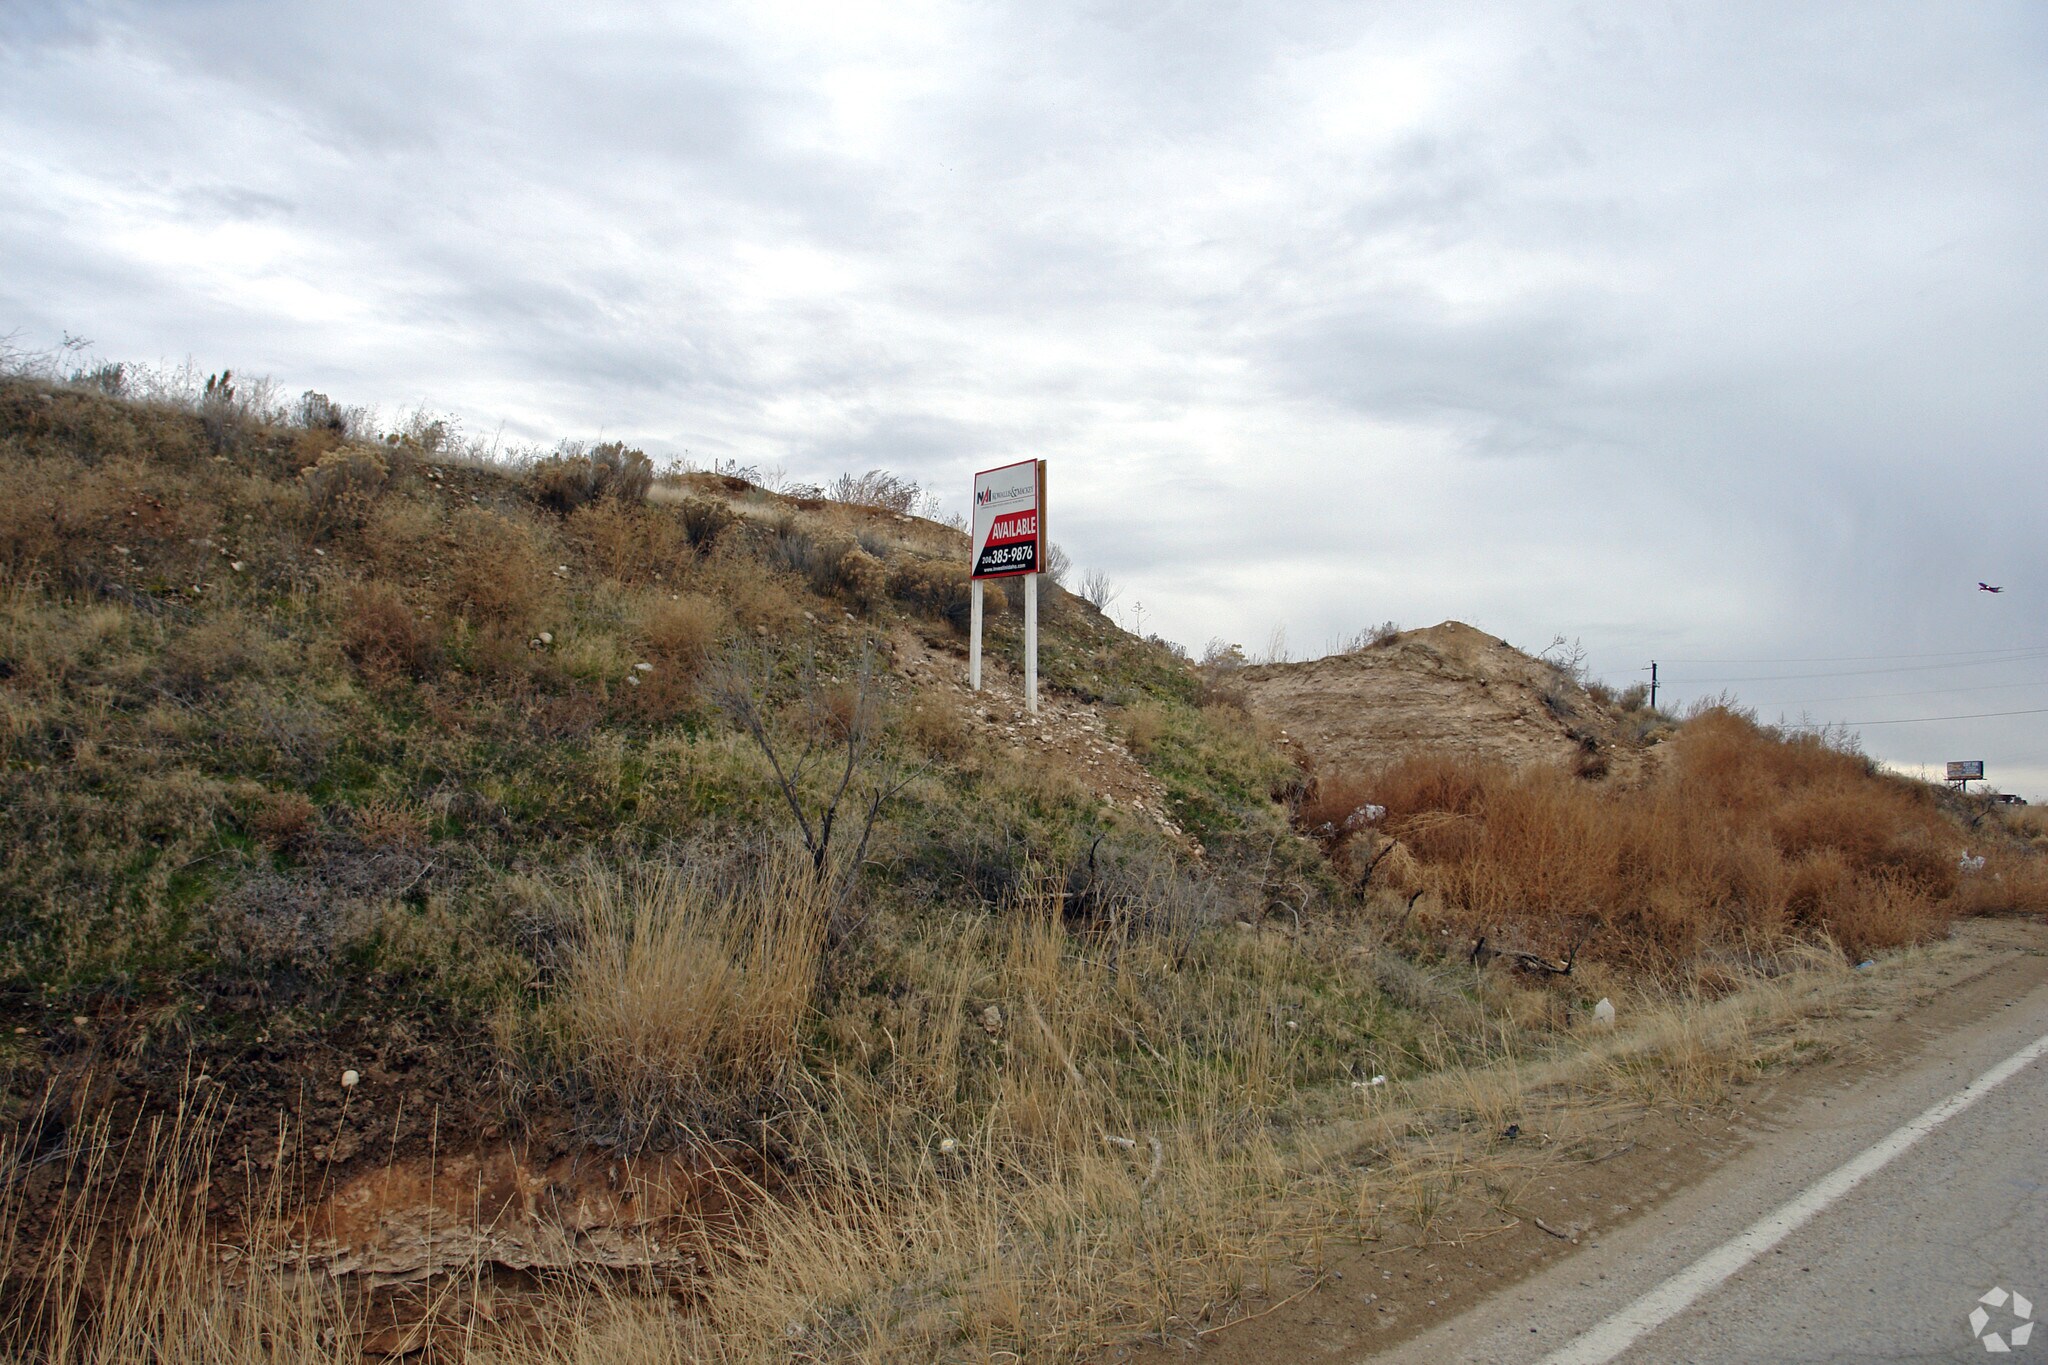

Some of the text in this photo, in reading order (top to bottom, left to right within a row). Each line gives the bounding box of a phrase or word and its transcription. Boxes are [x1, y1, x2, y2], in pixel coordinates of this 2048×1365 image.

[977, 486, 992, 506] NAI
[992, 516, 1036, 540] AVAILABLE
[991, 545, 1033, 565] 385-9876
